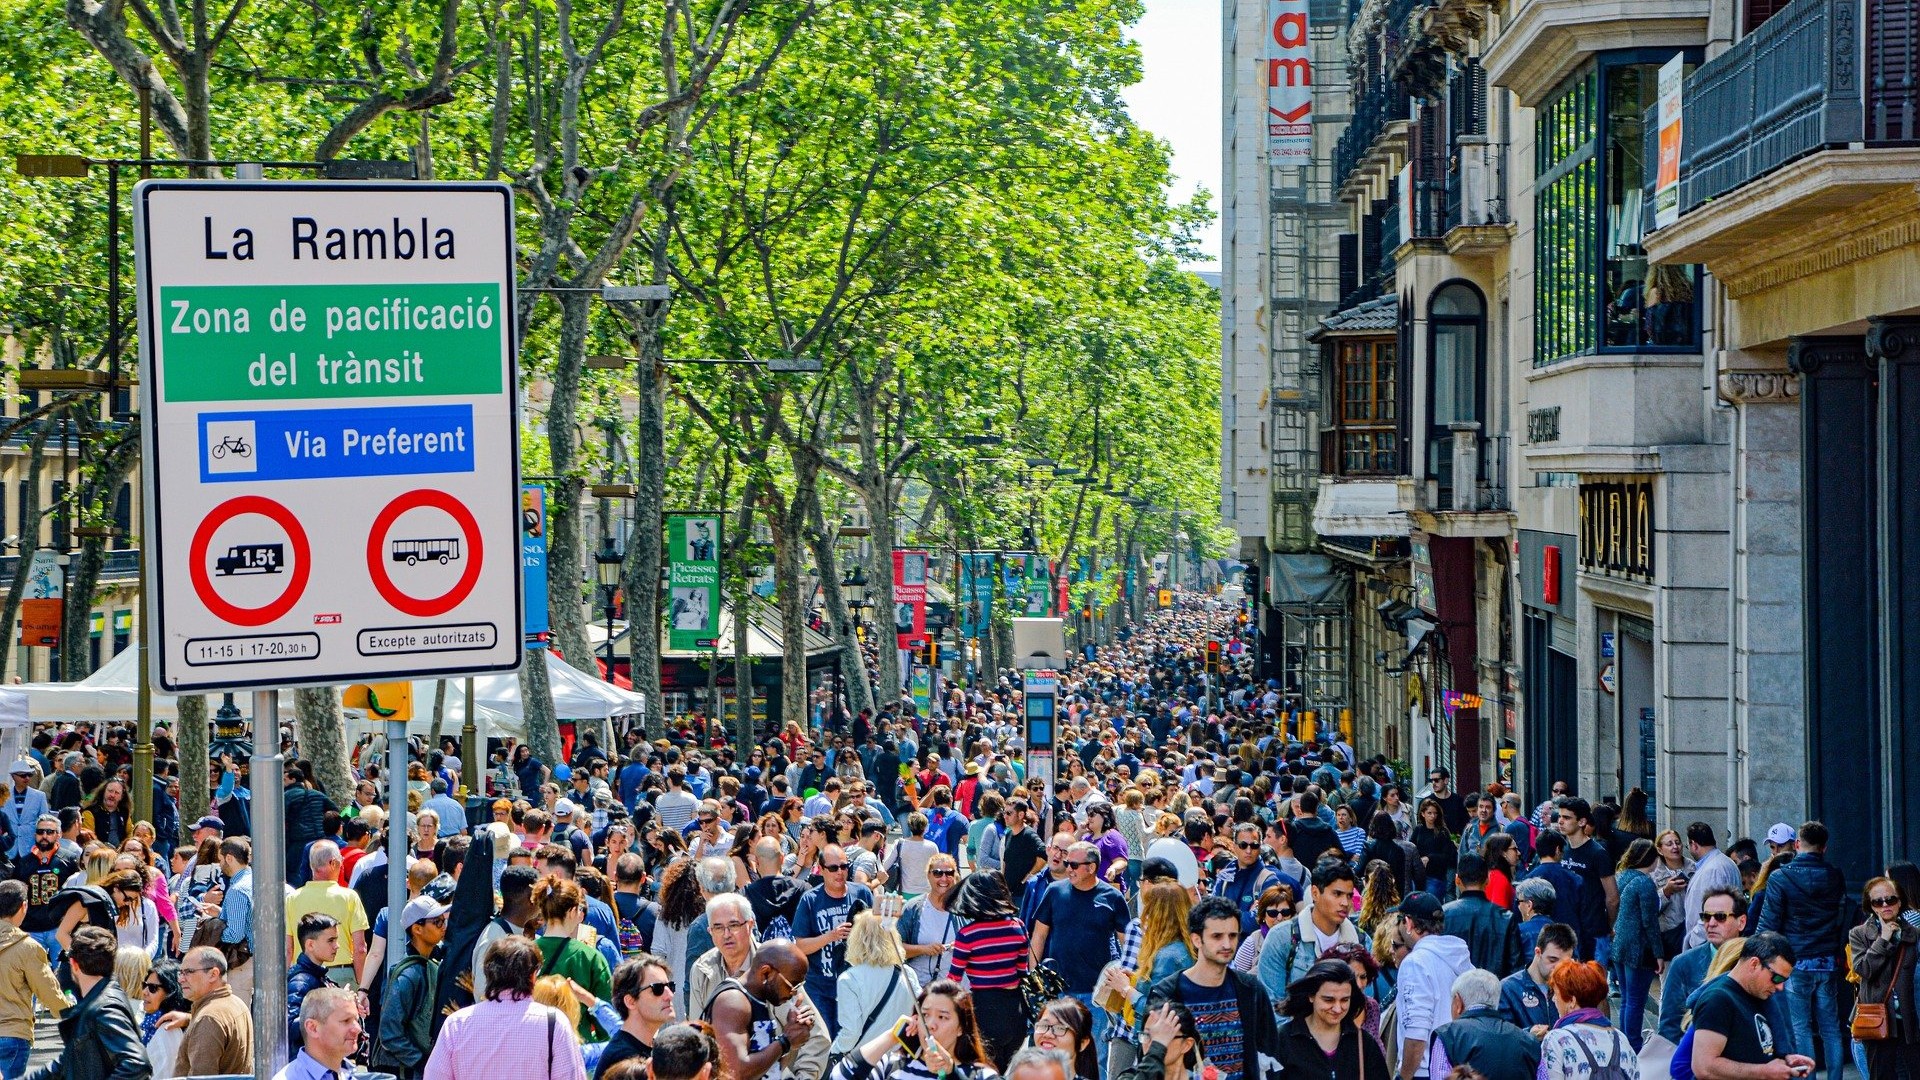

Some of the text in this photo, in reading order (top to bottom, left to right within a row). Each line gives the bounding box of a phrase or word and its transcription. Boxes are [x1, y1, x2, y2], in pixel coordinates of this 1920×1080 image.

[204, 216, 455, 261] La Rambla
[170, 296, 494, 339] Zona de pacificació
[248, 351, 424, 387] del trànsit
[284, 426, 466, 459] Via Preferent
[242, 548, 276, 567] 1,5t
[672, 562, 718, 573] Picasso.
[672, 573, 715, 584] Retrats
[370, 631, 486, 649] Excepte autoritzats
[200, 645, 233, 658] 11-15
[240, 644, 244, 656] i
